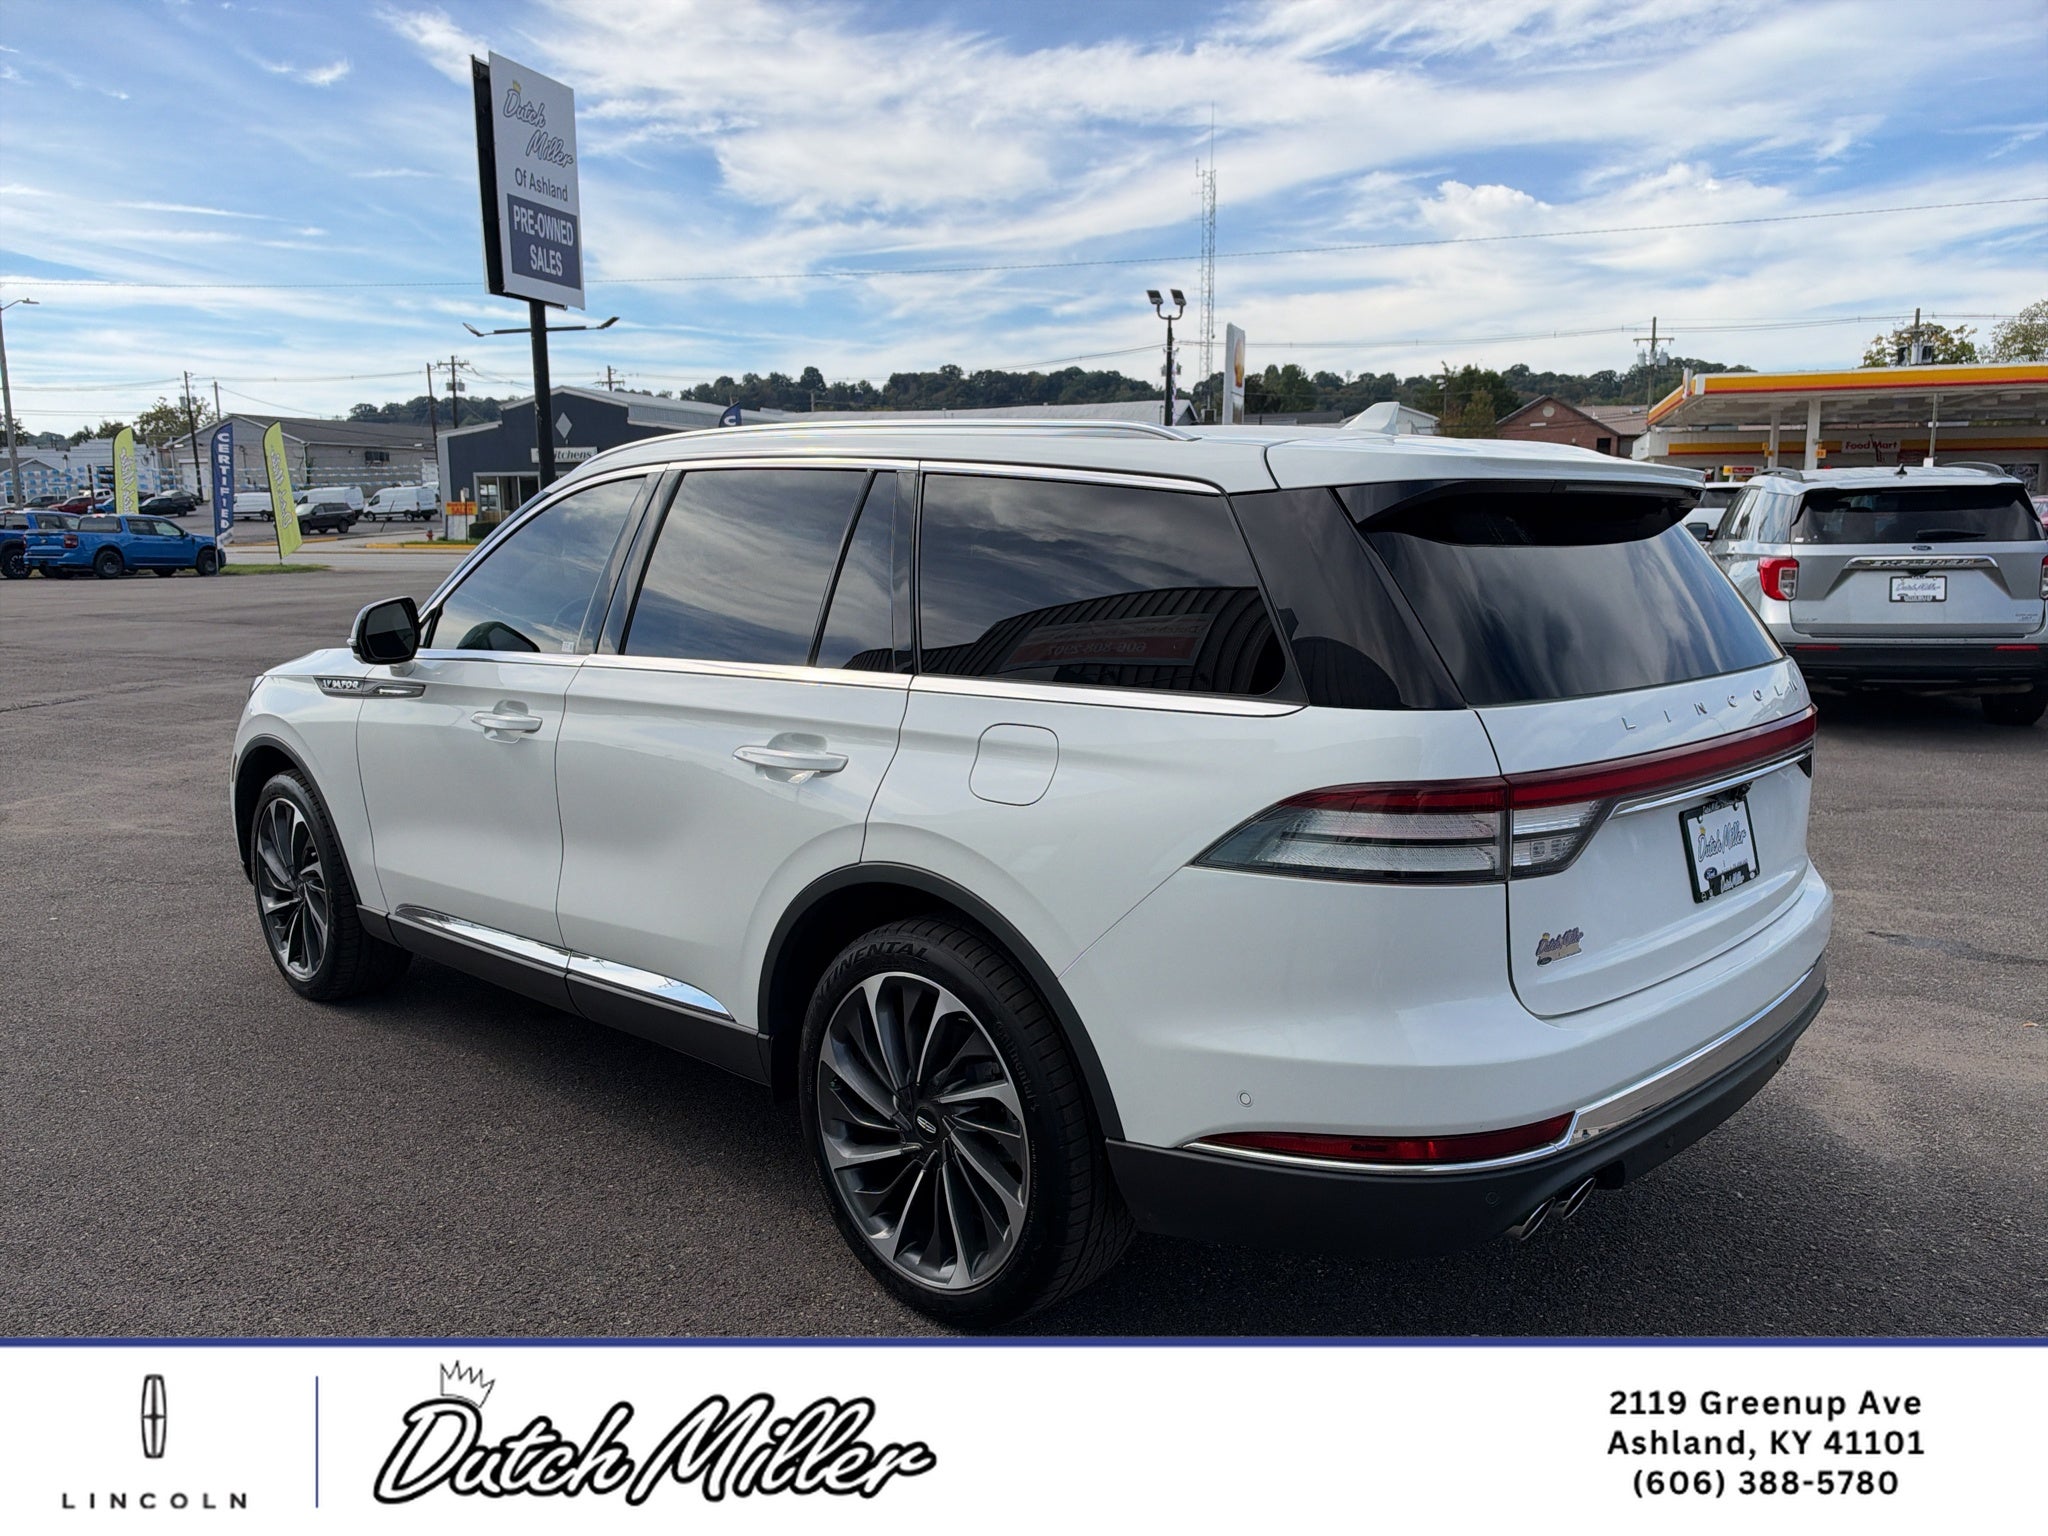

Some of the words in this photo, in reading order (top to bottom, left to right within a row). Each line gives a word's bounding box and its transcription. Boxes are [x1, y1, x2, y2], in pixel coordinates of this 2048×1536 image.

[503, 88, 546, 128] Dutch
[526, 129, 573, 168] Miller
[515, 167, 527, 187] Of
[529, 171, 568, 202] Ashland
[513, 205, 573, 246] PRE-OWNED
[529, 244, 562, 277] SALES
[1846, 440, 1870, 449] Food
[1873, 441, 1897, 449] Mart
[217, 433, 230, 529] CERTIFIED
[1621, 679, 1798, 731] LINCOLN
[1697, 829, 1723, 863] Dutch
[1721, 820, 1747, 854] Miller
